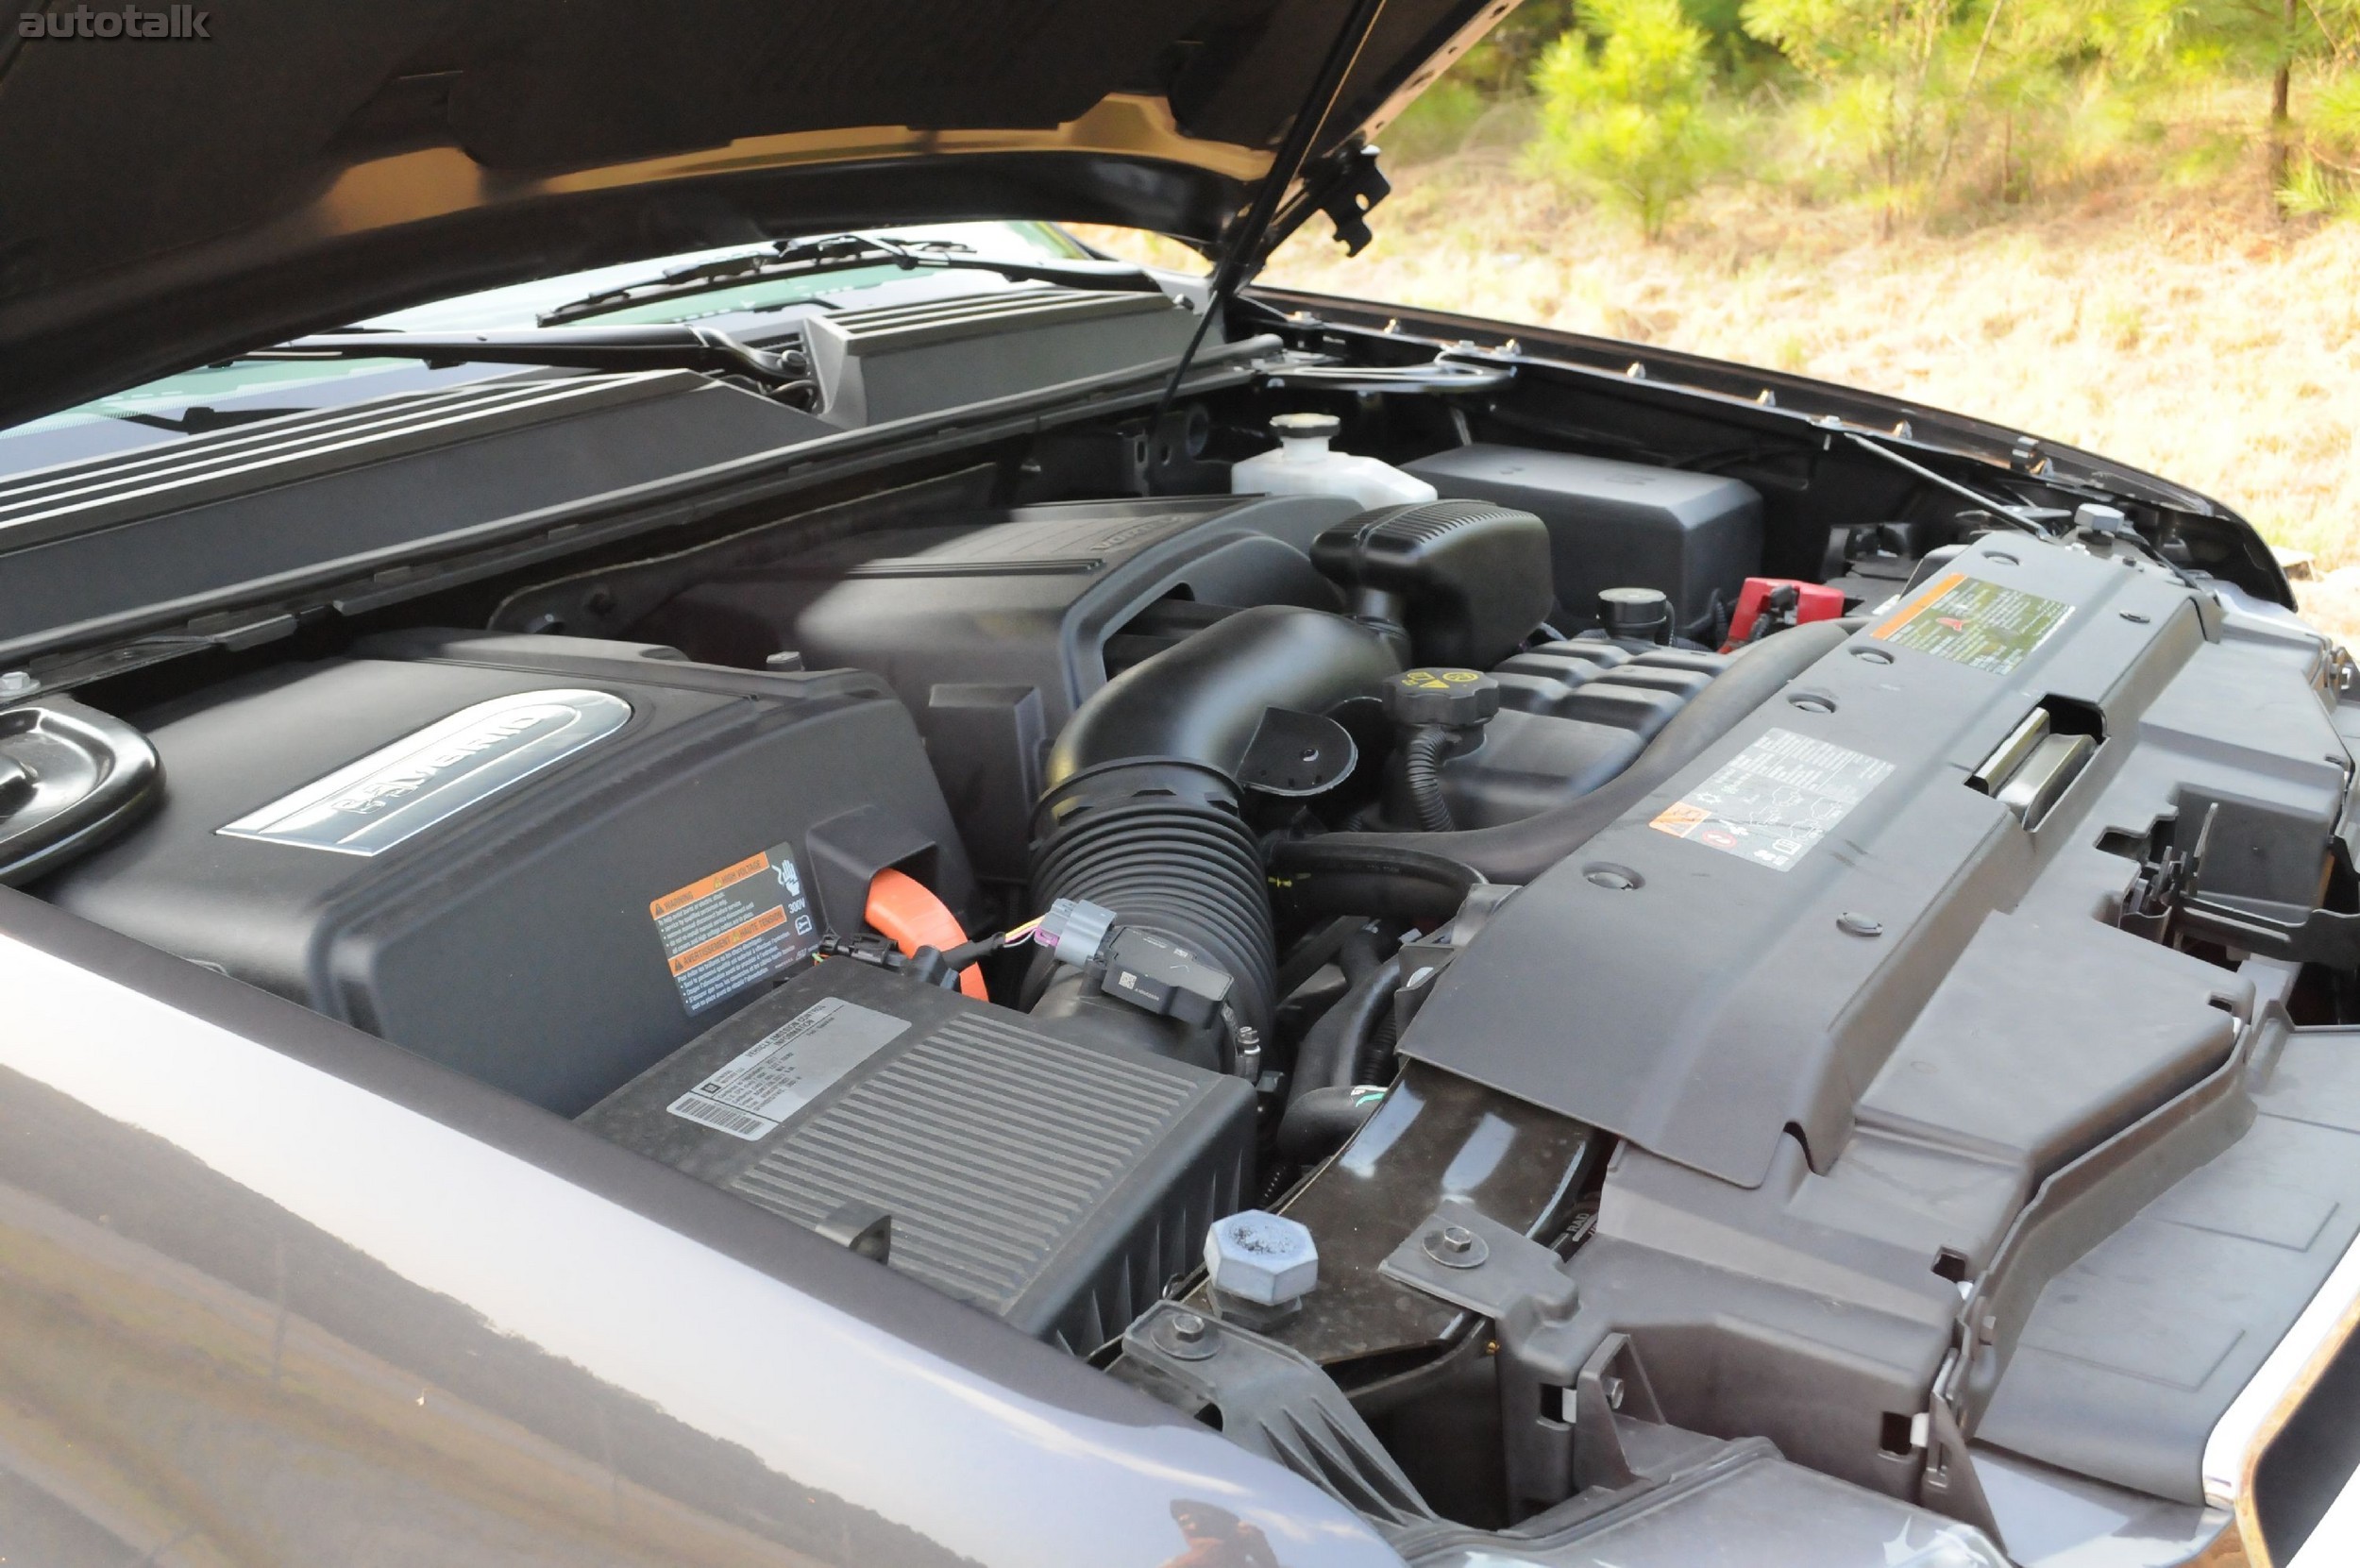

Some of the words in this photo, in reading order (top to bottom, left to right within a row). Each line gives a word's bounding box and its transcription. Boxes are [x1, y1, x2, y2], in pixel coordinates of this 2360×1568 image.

[721, 871, 736, 885] HIGH
[736, 860, 762, 877] VOLTAGE
[664, 891, 694, 911] WARNING
[787, 897, 806, 914] 300V
[739, 922, 758, 937] HAUTE
[683, 936, 731, 966] AVERTISSEMENT
[744, 1040, 772, 1057] VEHICLE
[768, 1020, 801, 1040] EMISSION
[796, 1003, 826, 1022] CONTROL
[772, 1019, 816, 1046] INFORMATION
[1566, 1213, 1590, 1233] RAD
